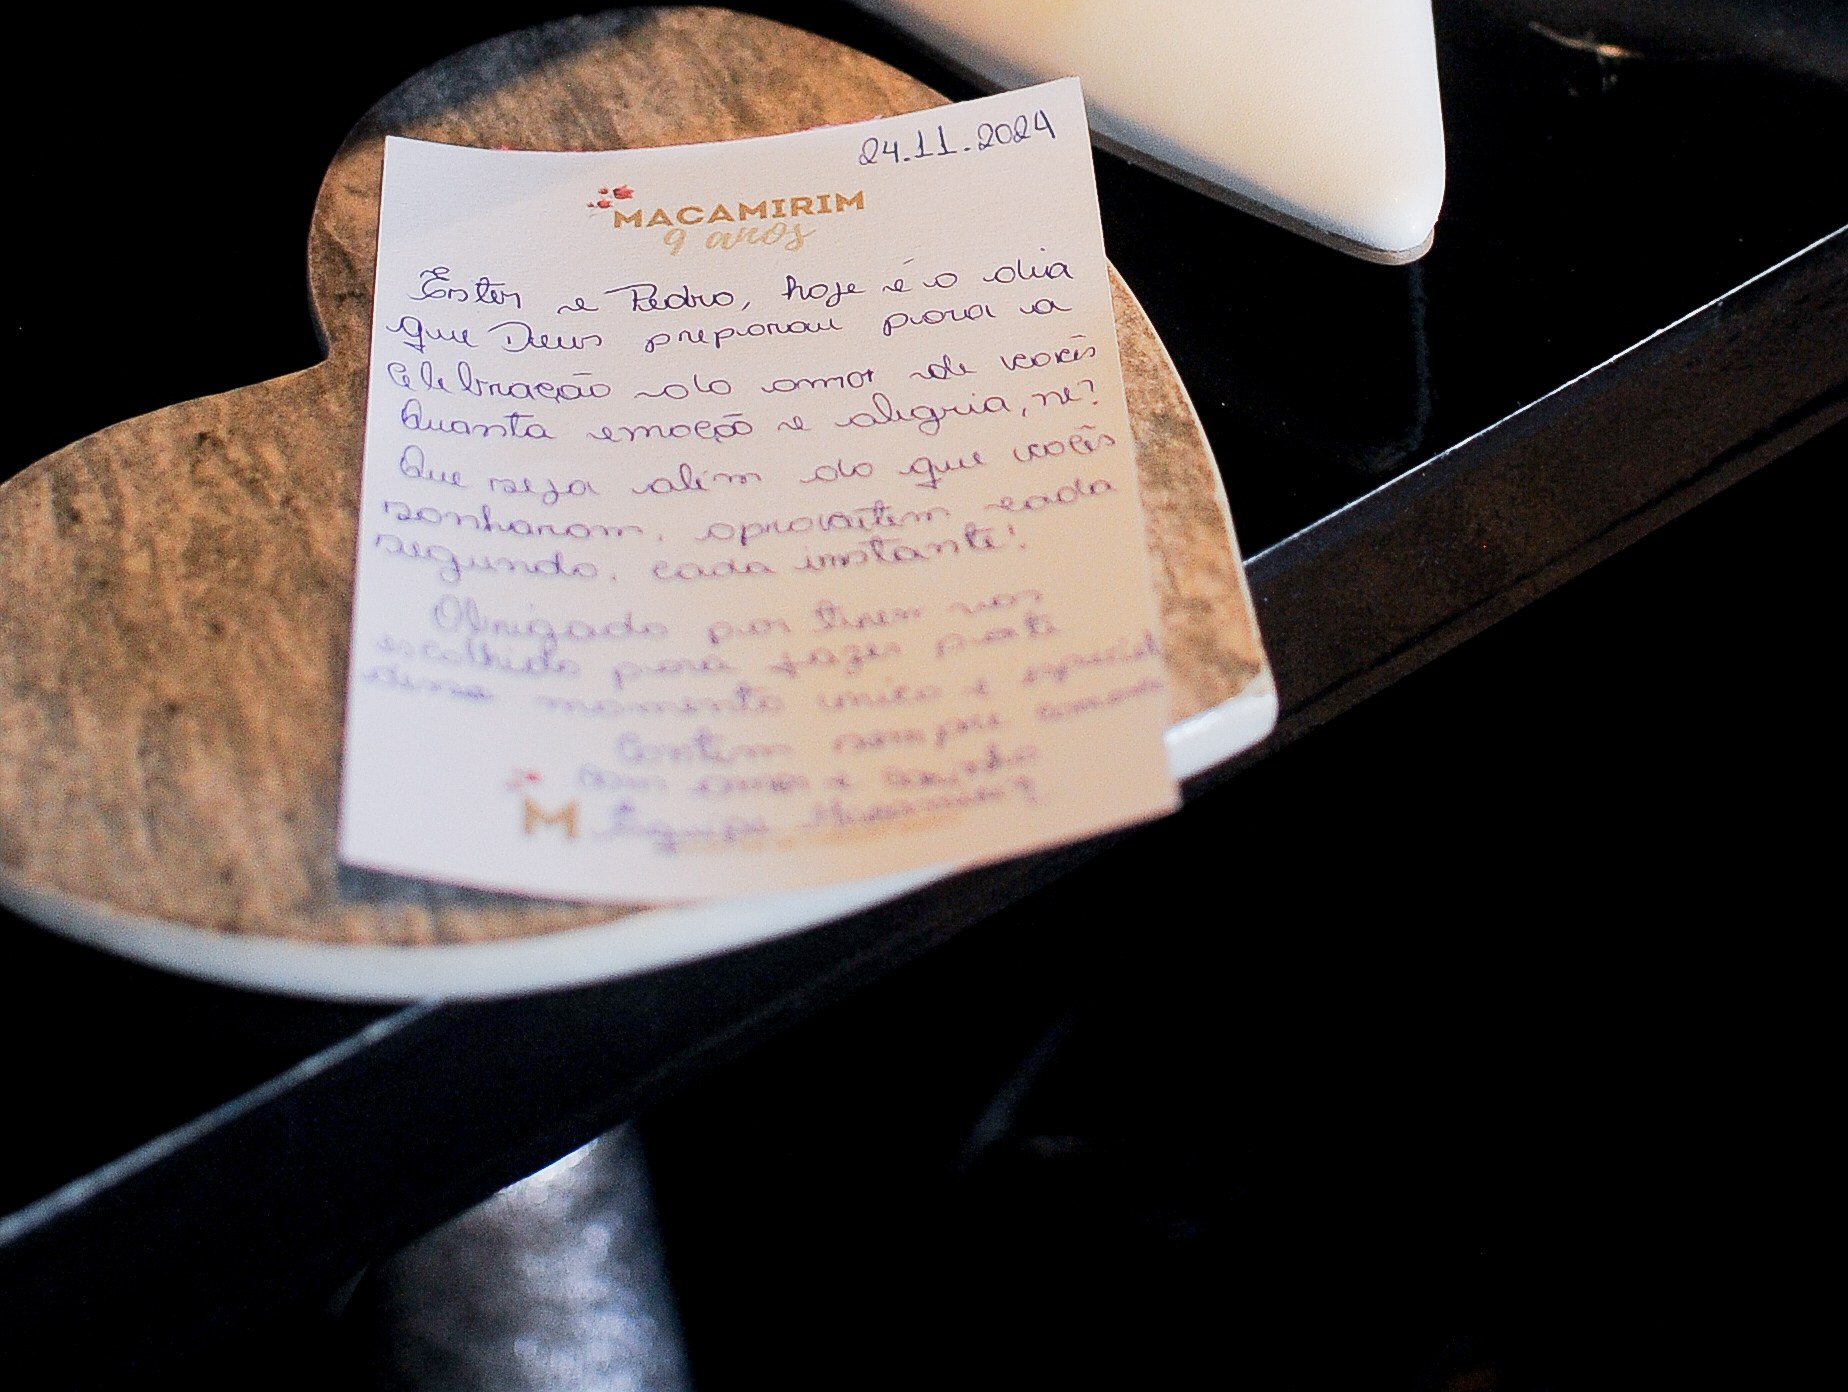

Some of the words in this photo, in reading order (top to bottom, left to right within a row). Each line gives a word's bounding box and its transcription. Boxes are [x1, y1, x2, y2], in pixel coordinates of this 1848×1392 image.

[858, 109, 1057, 166] 24.11.2024
[613, 190, 866, 230] MACAMIRIM
[663, 226, 687, 256] 9
[704, 220, 817, 252] anos
[407, 266, 522, 310] Ester
[557, 296, 600, 315] e
[604, 282, 751, 312] Pedro,
[781, 274, 867, 308] hoje
[882, 258, 913, 294] é
[923, 272, 959, 290] o
[983, 248, 1075, 283] dia
[386, 316, 480, 354] que
[487, 320, 603, 353] Deus
[645, 316, 843, 354] preparou
[882, 303, 998, 337] para
[1019, 298, 1073, 315] a
[634, 372, 733, 401] do
[761, 368, 875, 394] amor
[909, 353, 977, 381] de
[401, 397, 557, 440] Quanta
[586, 410, 754, 443] emoção
[777, 414, 811, 432] e
[834, 392, 1028, 436] alegria,
[400, 444, 468, 489] Que
[489, 476, 601, 506] seja
[799, 459, 874, 484] do
[898, 450, 989, 490] que
[984, 476, 1119, 511] cada
[652, 558, 777, 581] cada
[706, 620, 792, 646] por
[523, 797, 579, 841] M
